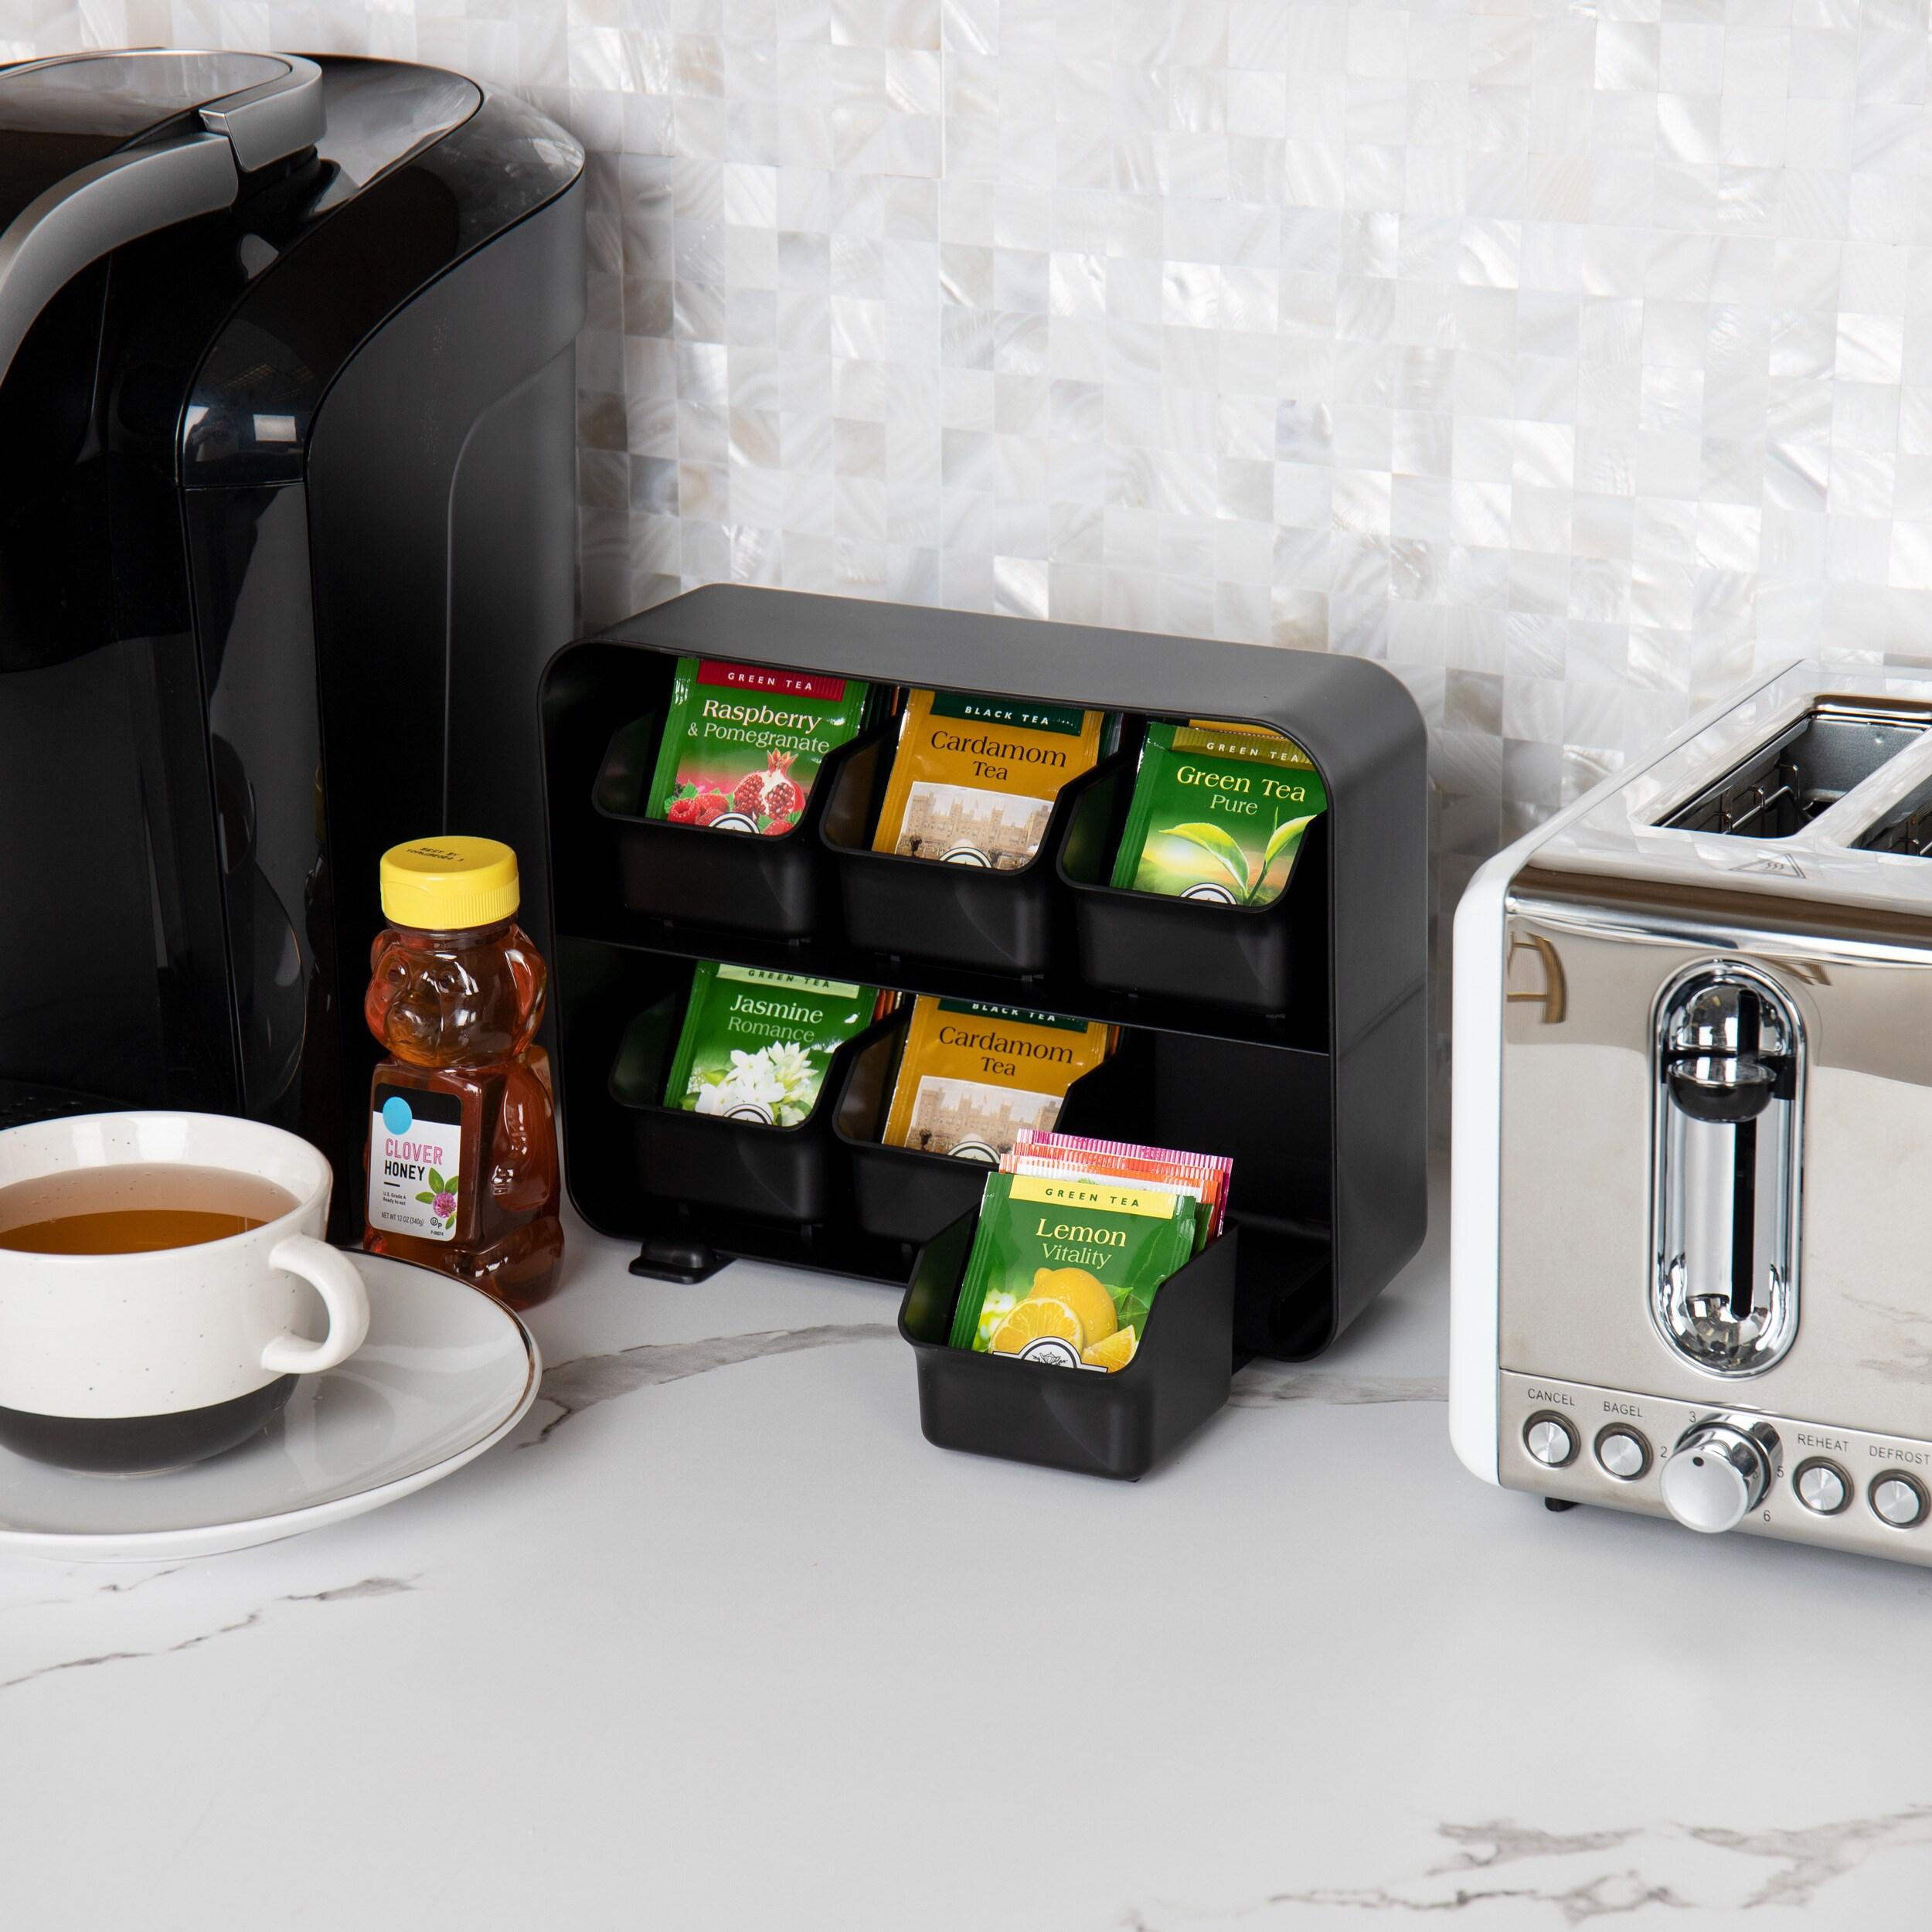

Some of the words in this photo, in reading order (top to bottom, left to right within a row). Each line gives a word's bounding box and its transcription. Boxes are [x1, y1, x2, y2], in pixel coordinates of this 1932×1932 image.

[728, 672, 776, 685] GREEN
[786, 679, 813, 691] TEA
[702, 699, 822, 734] Raspberry
[964, 706, 1012, 719] BLACK
[1022, 714, 1049, 725] TEA
[688, 723, 698, 736] &
[704, 723, 830, 754] Pomegranate
[930, 730, 1066, 767] Cardamom
[1206, 742, 1259, 757] GREEN
[1270, 751, 1298, 763] TEA
[973, 760, 1008, 781] Tea
[1177, 766, 1250, 793] Green
[1260, 778, 1306, 802] Tea
[1209, 794, 1258, 815] Pure
[748, 970, 794, 982] GREEN
[804, 977, 829, 988] TEA
[730, 995, 824, 1024] Jasmine
[972, 1003, 1019, 1015] BLACK
[1029, 1012, 1056, 1022] TEA
[727, 1016, 815, 1043] Romance
[939, 1026, 1074, 1064] Cardamom
[981, 1056, 1016, 1077] Tea
[385, 1138, 443, 1165] CLOVER
[384, 1159, 425, 1181] HONEY
[1045, 1188, 1098, 1202] GREEN
[1110, 1196, 1139, 1207] TEA
[410, 1217, 424, 1226] (340g)
[1036, 1218, 1127, 1247] Lemon
[1043, 1243, 1112, 1270] Vitality
[1528, 1388, 1576, 1406] CANCEL
[1604, 1401, 1643, 1417] BAGEL
[1689, 1411, 1696, 1423] 3
[1660, 1446, 1668, 1458] 2
[1797, 1434, 1849, 1452] REHEAT
[1869, 1445, 1931, 1465] DEFROST
[1777, 1465, 1784, 1478] 5
[1763, 1509, 1771, 1522] 6
